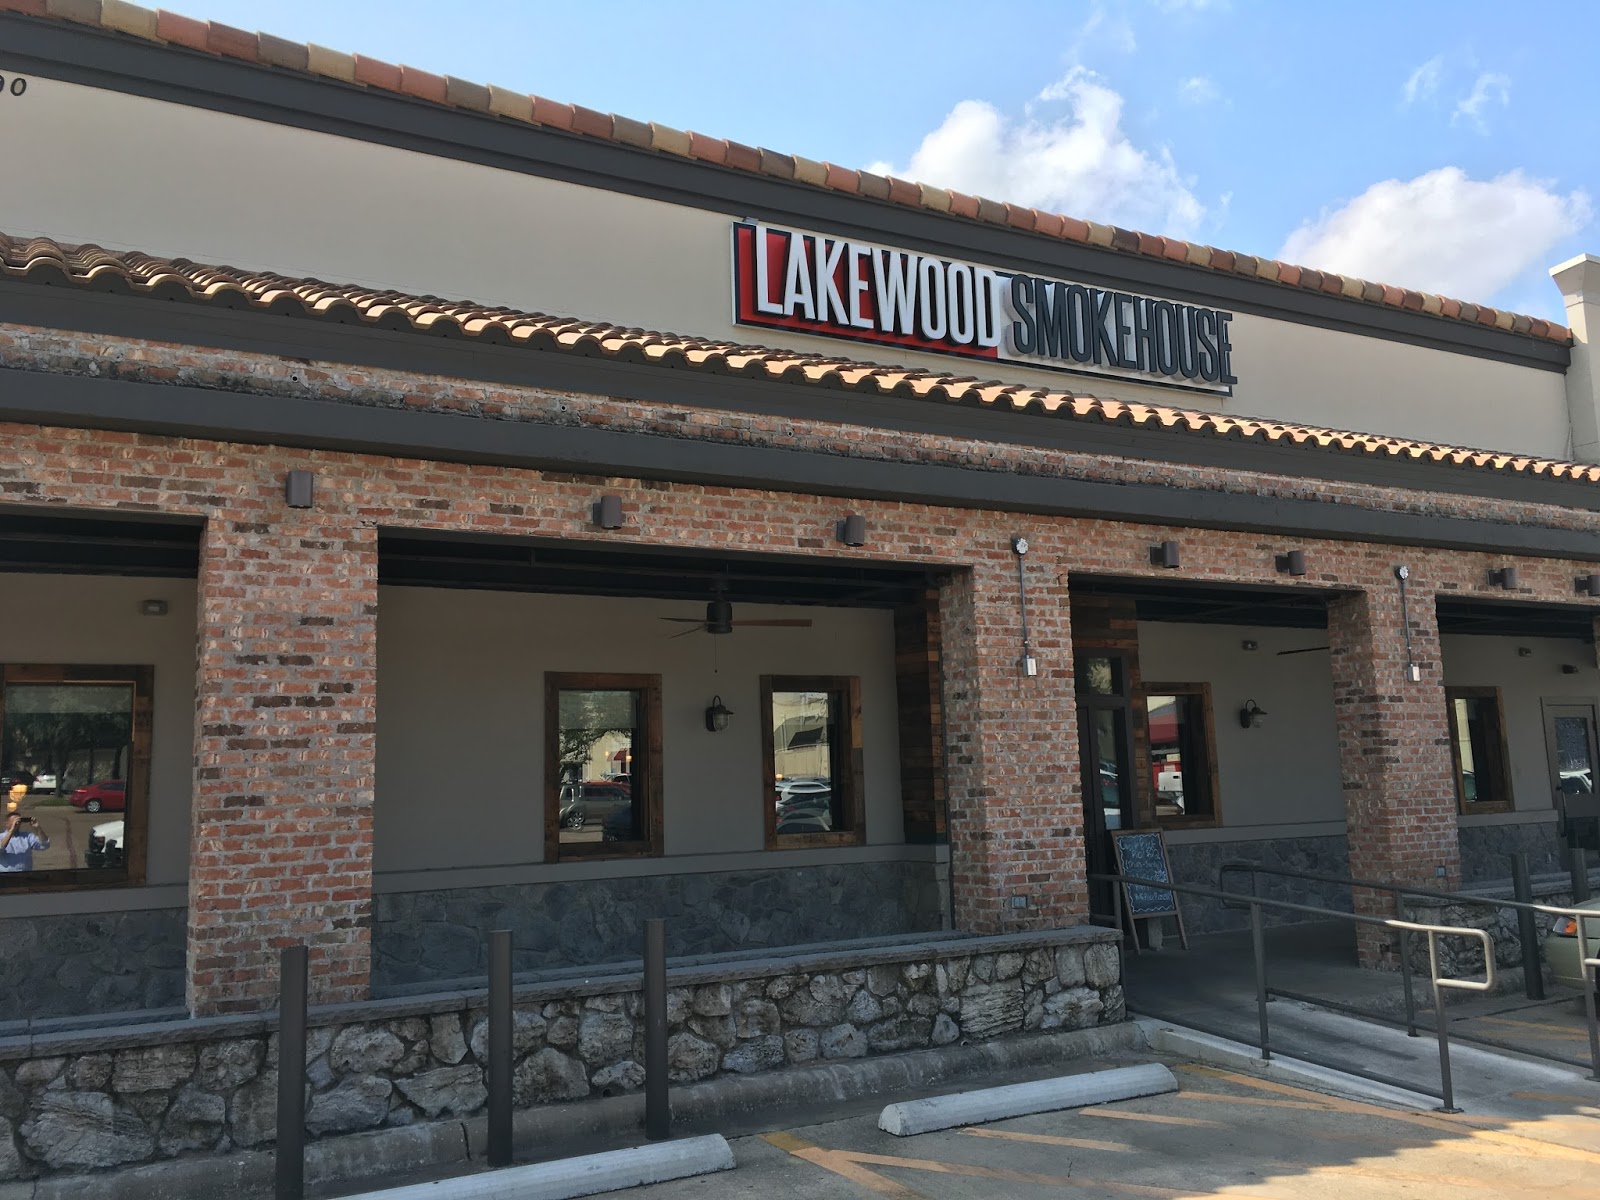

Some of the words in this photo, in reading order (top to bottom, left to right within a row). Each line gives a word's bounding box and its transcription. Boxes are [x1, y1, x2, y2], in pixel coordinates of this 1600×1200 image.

[0, 74, 27, 97] 0
[755, 225, 1001, 347] LAKEWOOD
[1010, 273, 1238, 385] SMOKEHOUSE
